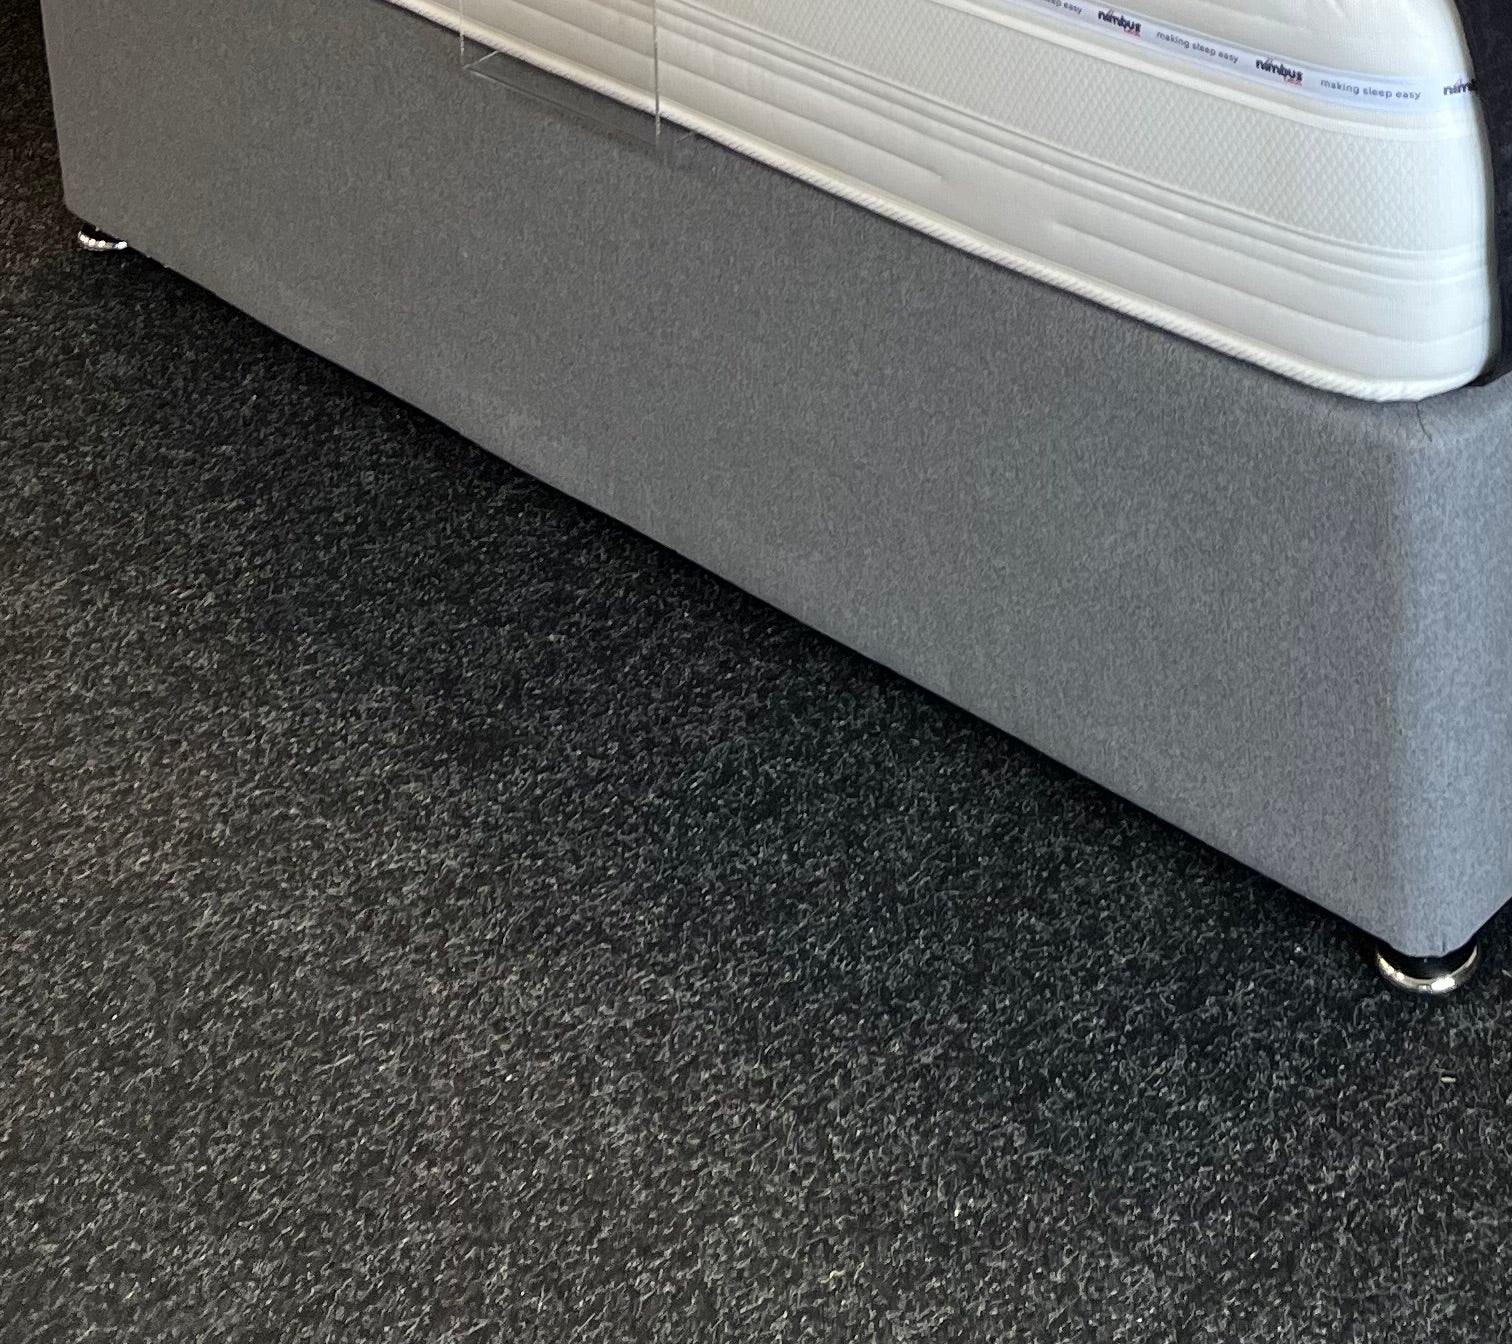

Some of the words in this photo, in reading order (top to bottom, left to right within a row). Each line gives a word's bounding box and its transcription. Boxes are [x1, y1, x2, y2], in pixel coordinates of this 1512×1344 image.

[1063, 2, 1082, 15] easy
[1098, 10, 1141, 33] nimbus
[1156, 31, 1189, 50] making
[1192, 42, 1216, 58] sleep
[1218, 51, 1239, 64] easy
[1256, 59, 1303, 81] nimbus
[1320, 79, 1359, 95] making
[1362, 86, 1393, 99] sleep
[1395, 90, 1422, 101] easy
